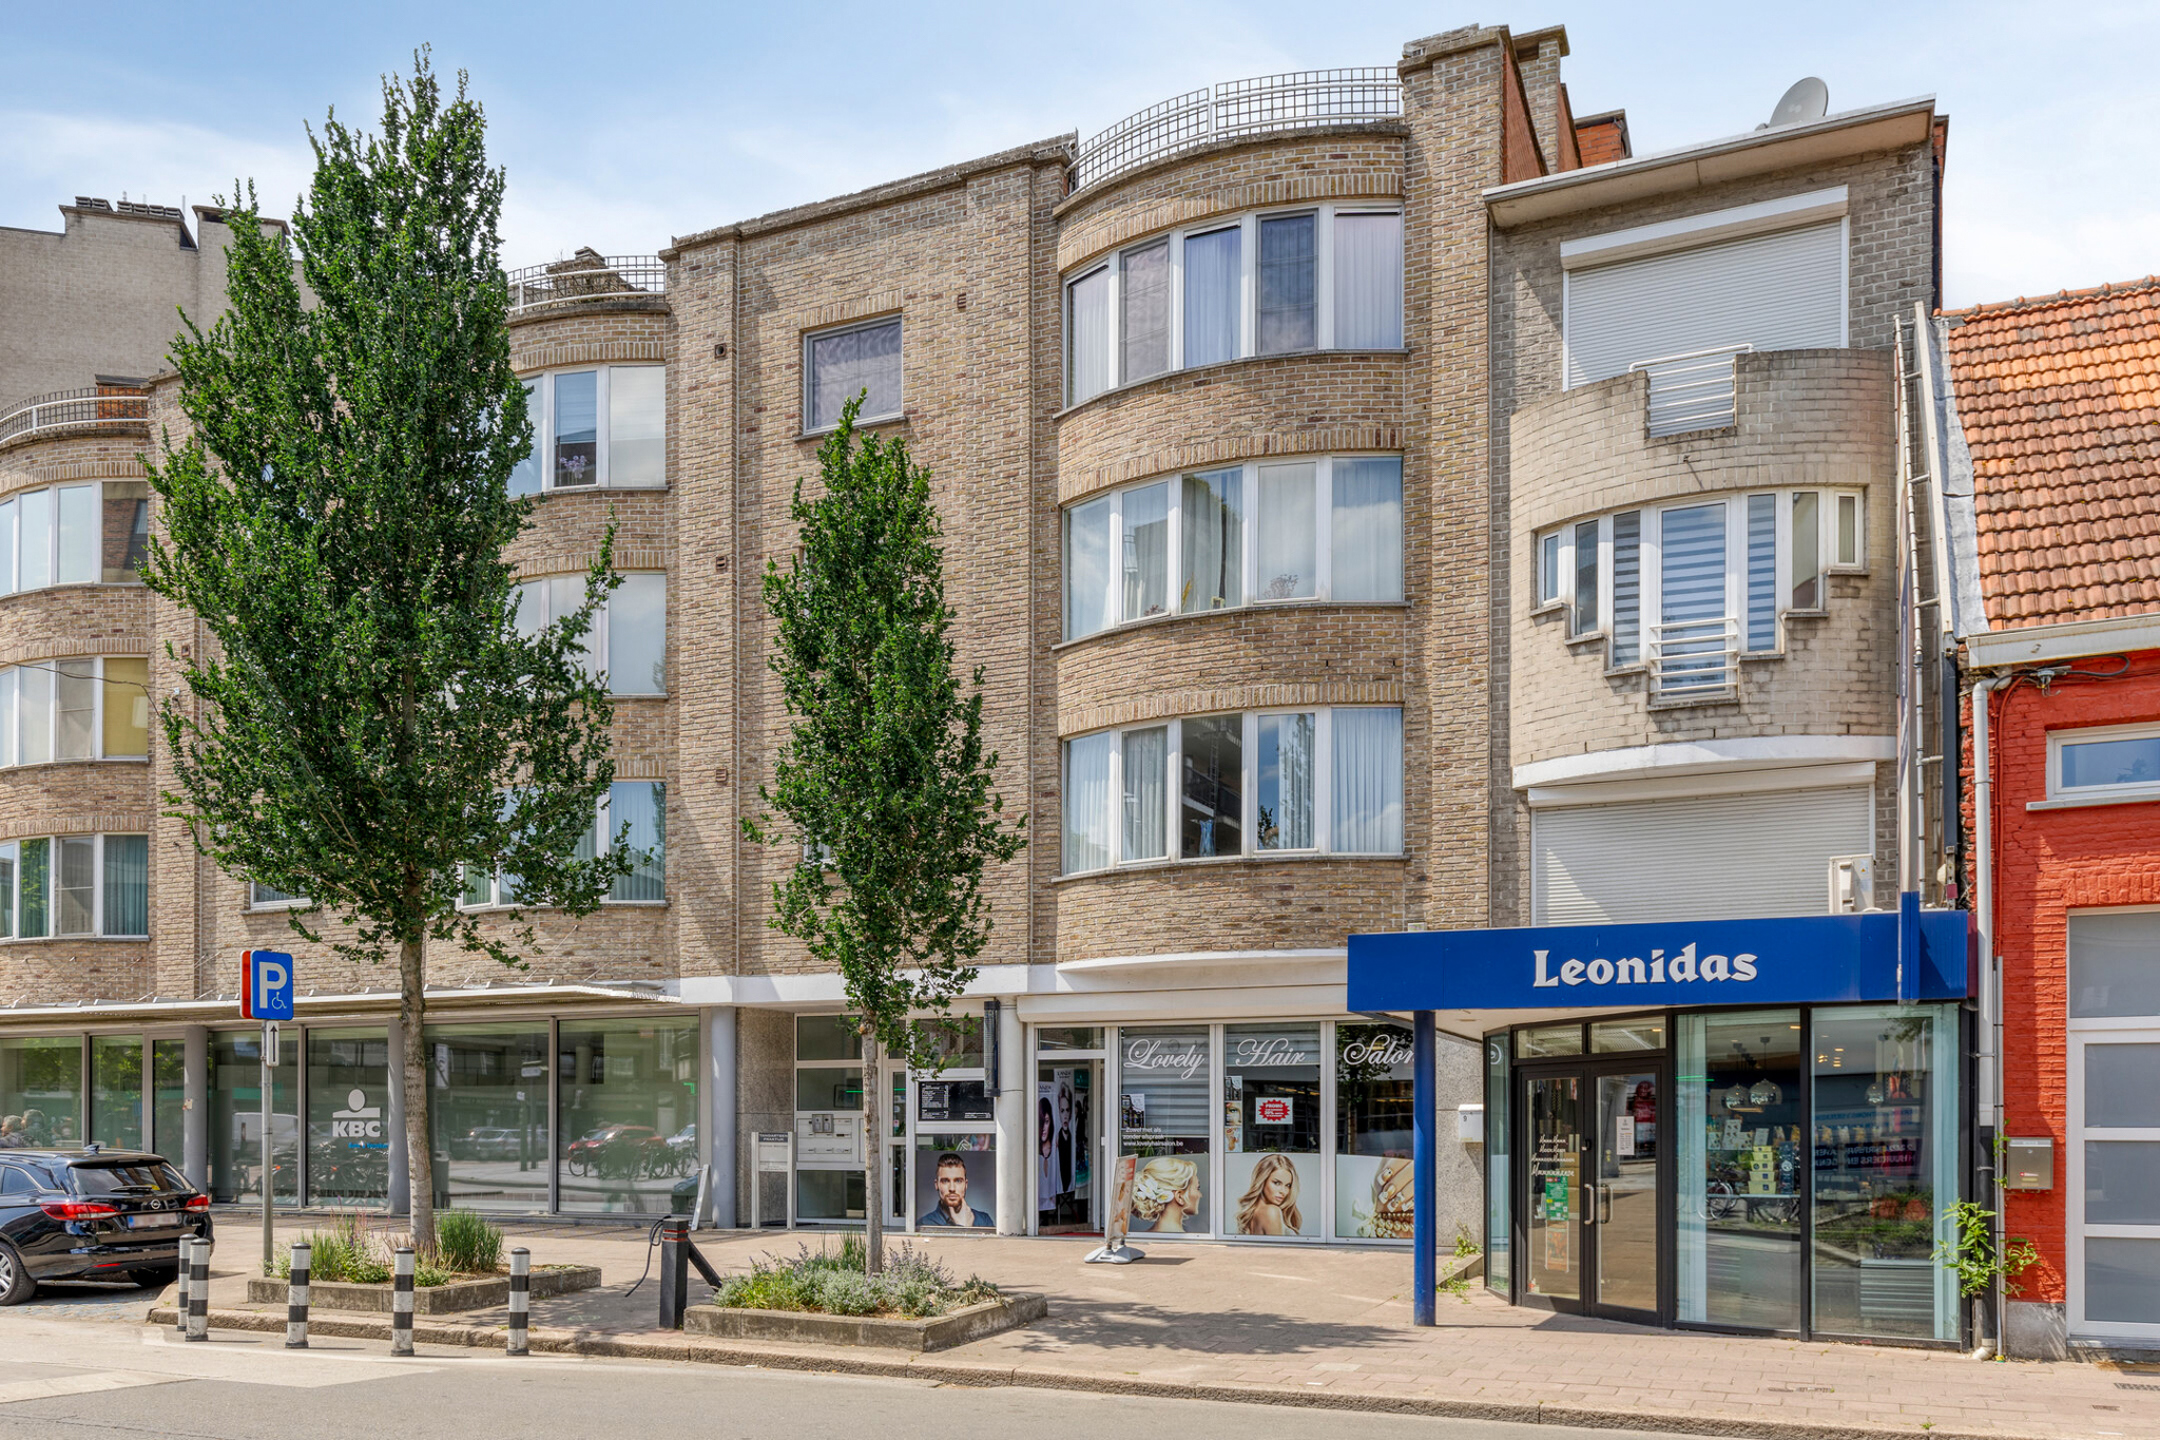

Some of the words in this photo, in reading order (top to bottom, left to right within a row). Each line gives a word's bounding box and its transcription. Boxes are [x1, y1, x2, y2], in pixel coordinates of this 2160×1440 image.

[259, 961, 288, 1009] P
[1533, 942, 1758, 987] Leonidas
[1123, 1038, 1205, 1080] Lovely
[1235, 1037, 1306, 1067] Hair
[332, 1120, 381, 1138] KBC
